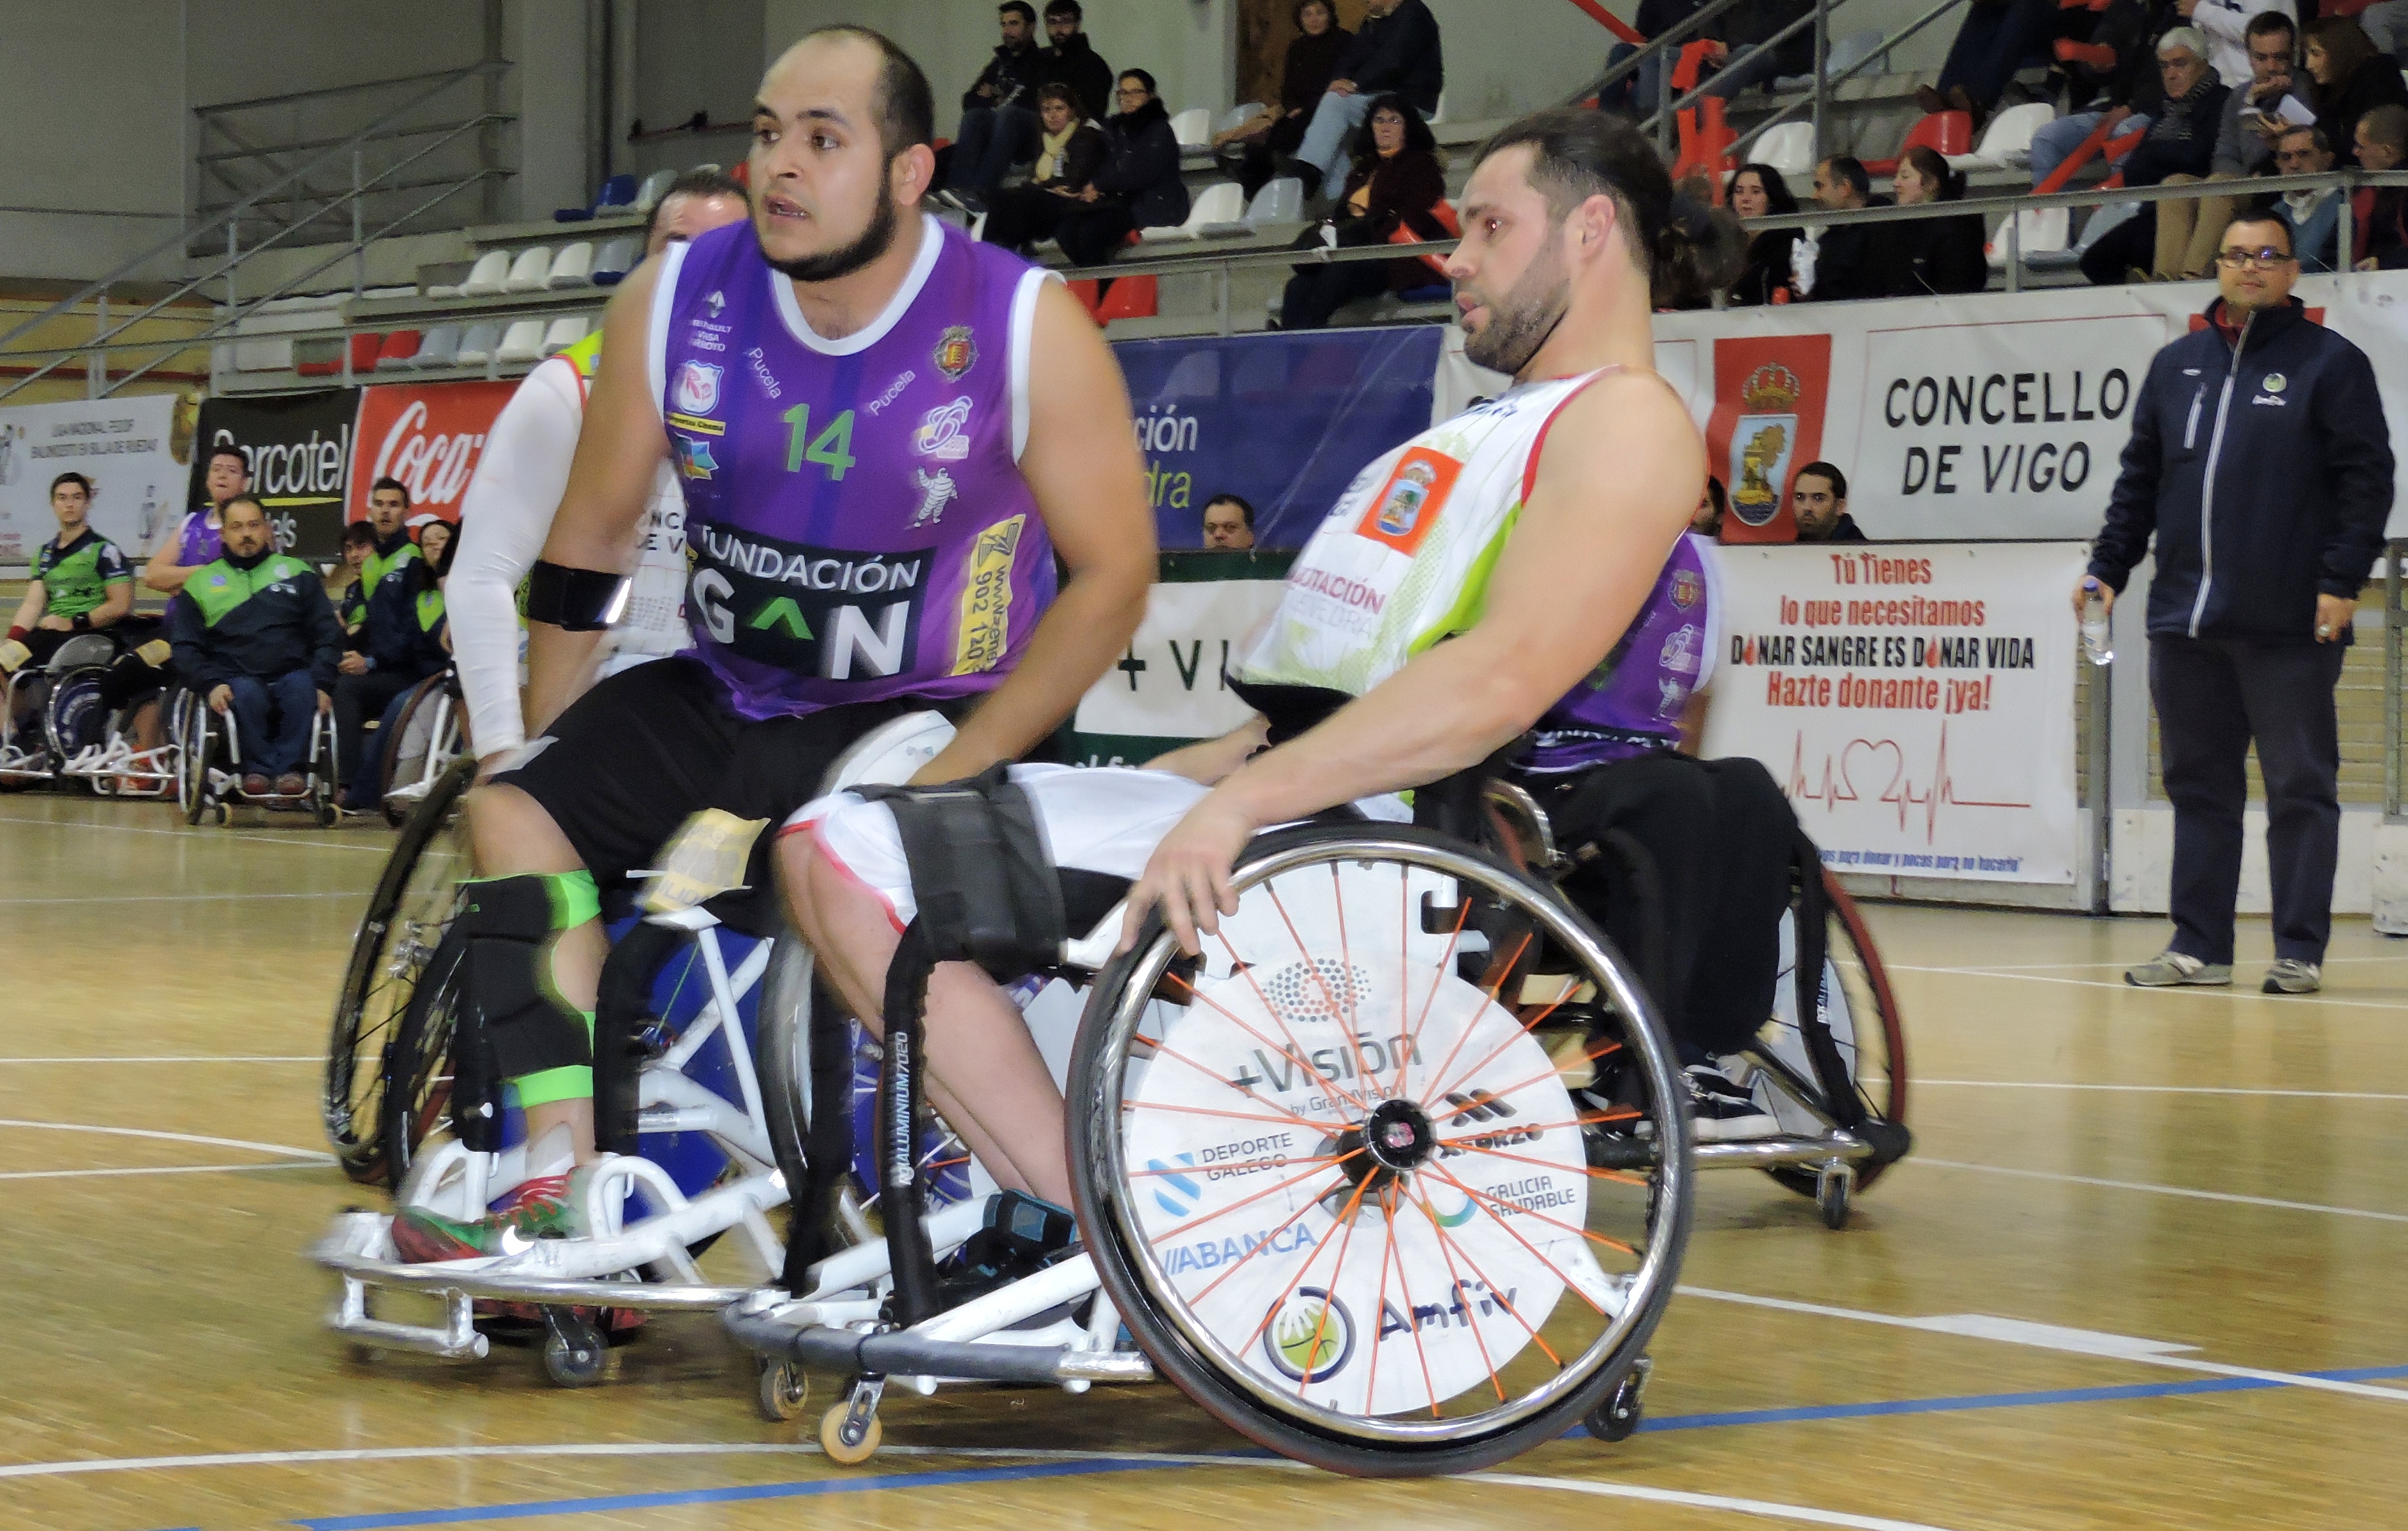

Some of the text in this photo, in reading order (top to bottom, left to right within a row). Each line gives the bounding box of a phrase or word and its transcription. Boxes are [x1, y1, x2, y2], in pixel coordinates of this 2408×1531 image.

[748, 347, 782, 399] Pucela
[869, 370, 916, 416] Pucela
[1885, 368, 2129, 428] CONCELLO
[783, 403, 856, 481] 14
[1903, 441, 2091, 495] DE VIGO
[1859, 551, 1933, 585] Tienes
[971, 570, 993, 615] 902
[1780, 594, 1986, 628] lo que necesitamos
[1800, 635, 1877, 667] SANGRE
[1884, 636, 1906, 667] ES
[1986, 637, 2036, 669] VIDA
[1767, 670, 1993, 714] Hazte donante ¡ya!
[1290, 1103, 1306, 1117] by
[1201, 1132, 1294, 1163] DEPORTE
[1205, 1153, 1288, 1182] GALEGO
[1485, 1175, 1553, 1200] GALICIA
[1489, 1188, 1577, 1218] SAUDABLE
[1379, 1278, 1518, 1342] Amfiv
